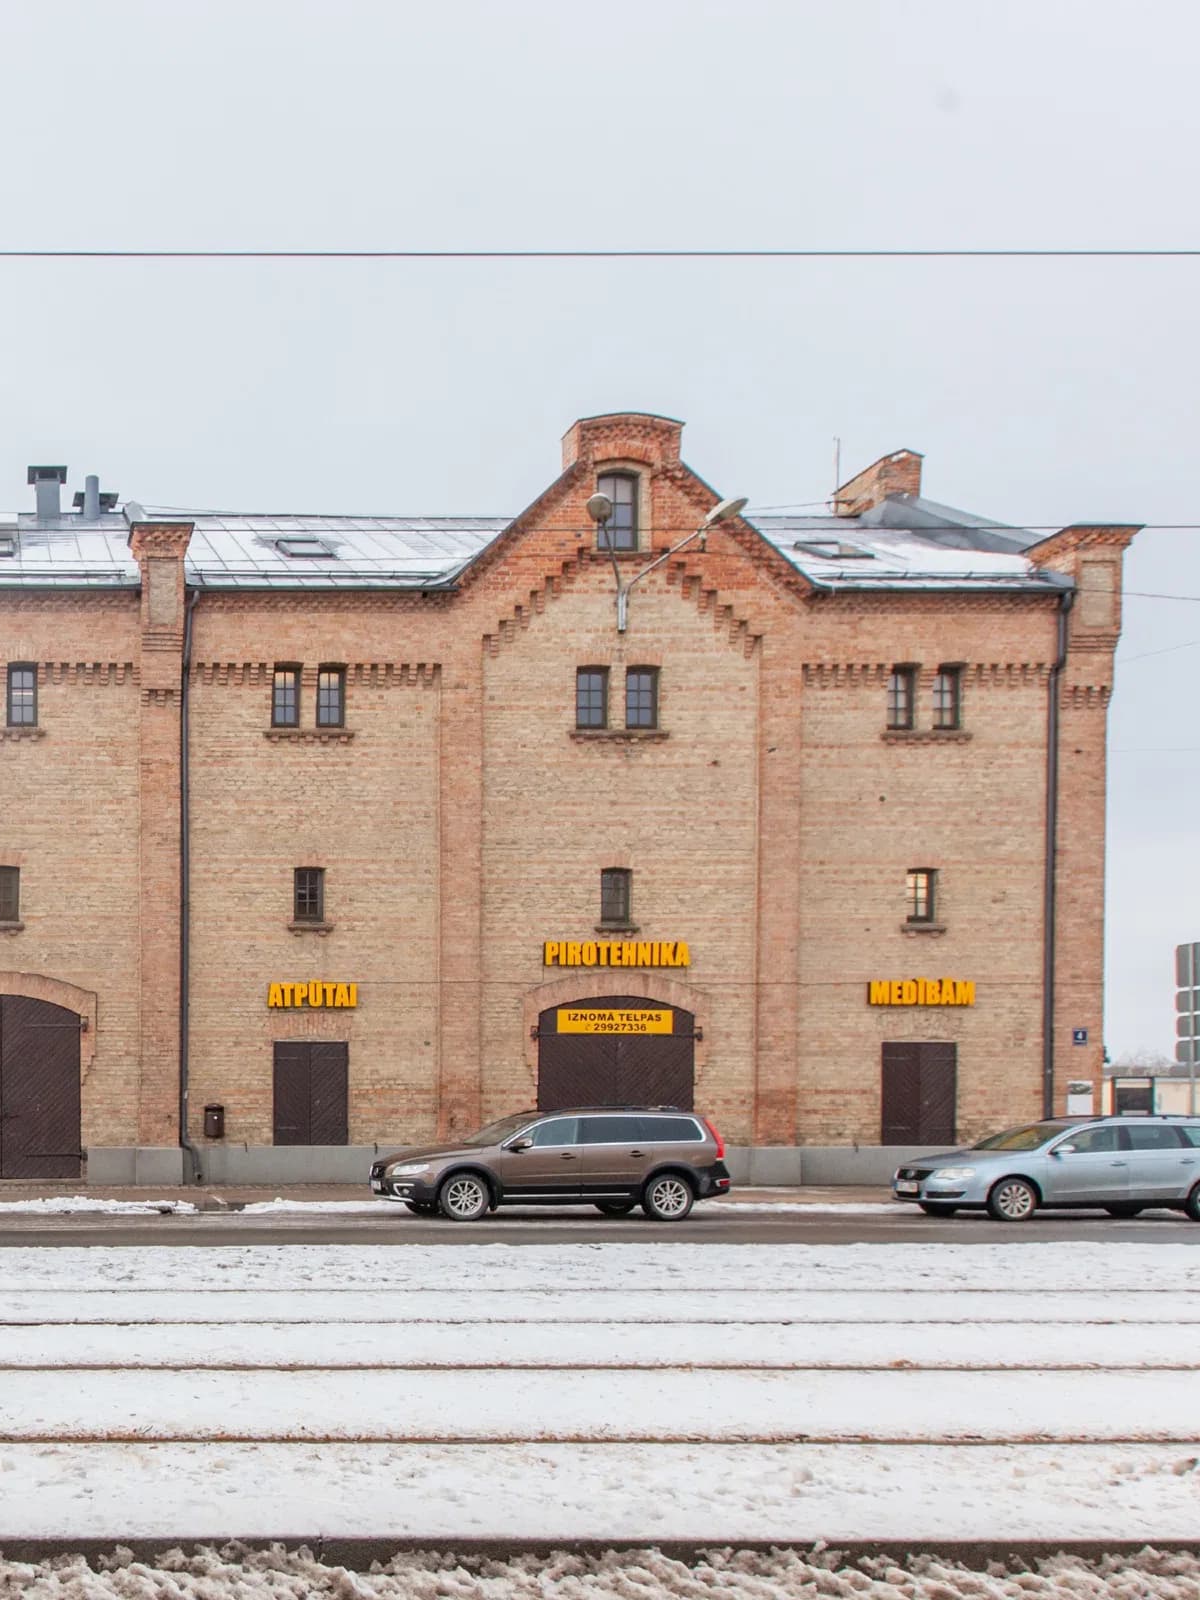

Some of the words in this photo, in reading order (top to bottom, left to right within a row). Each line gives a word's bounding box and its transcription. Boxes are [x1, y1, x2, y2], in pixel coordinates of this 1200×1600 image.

[544, 941, 691, 967] PIROTEHNIKA
[567, 1012, 615, 1021] IZNOMĀ
[618, 1013, 662, 1022] TELPAS
[593, 1023, 647, 1031] 29927336
